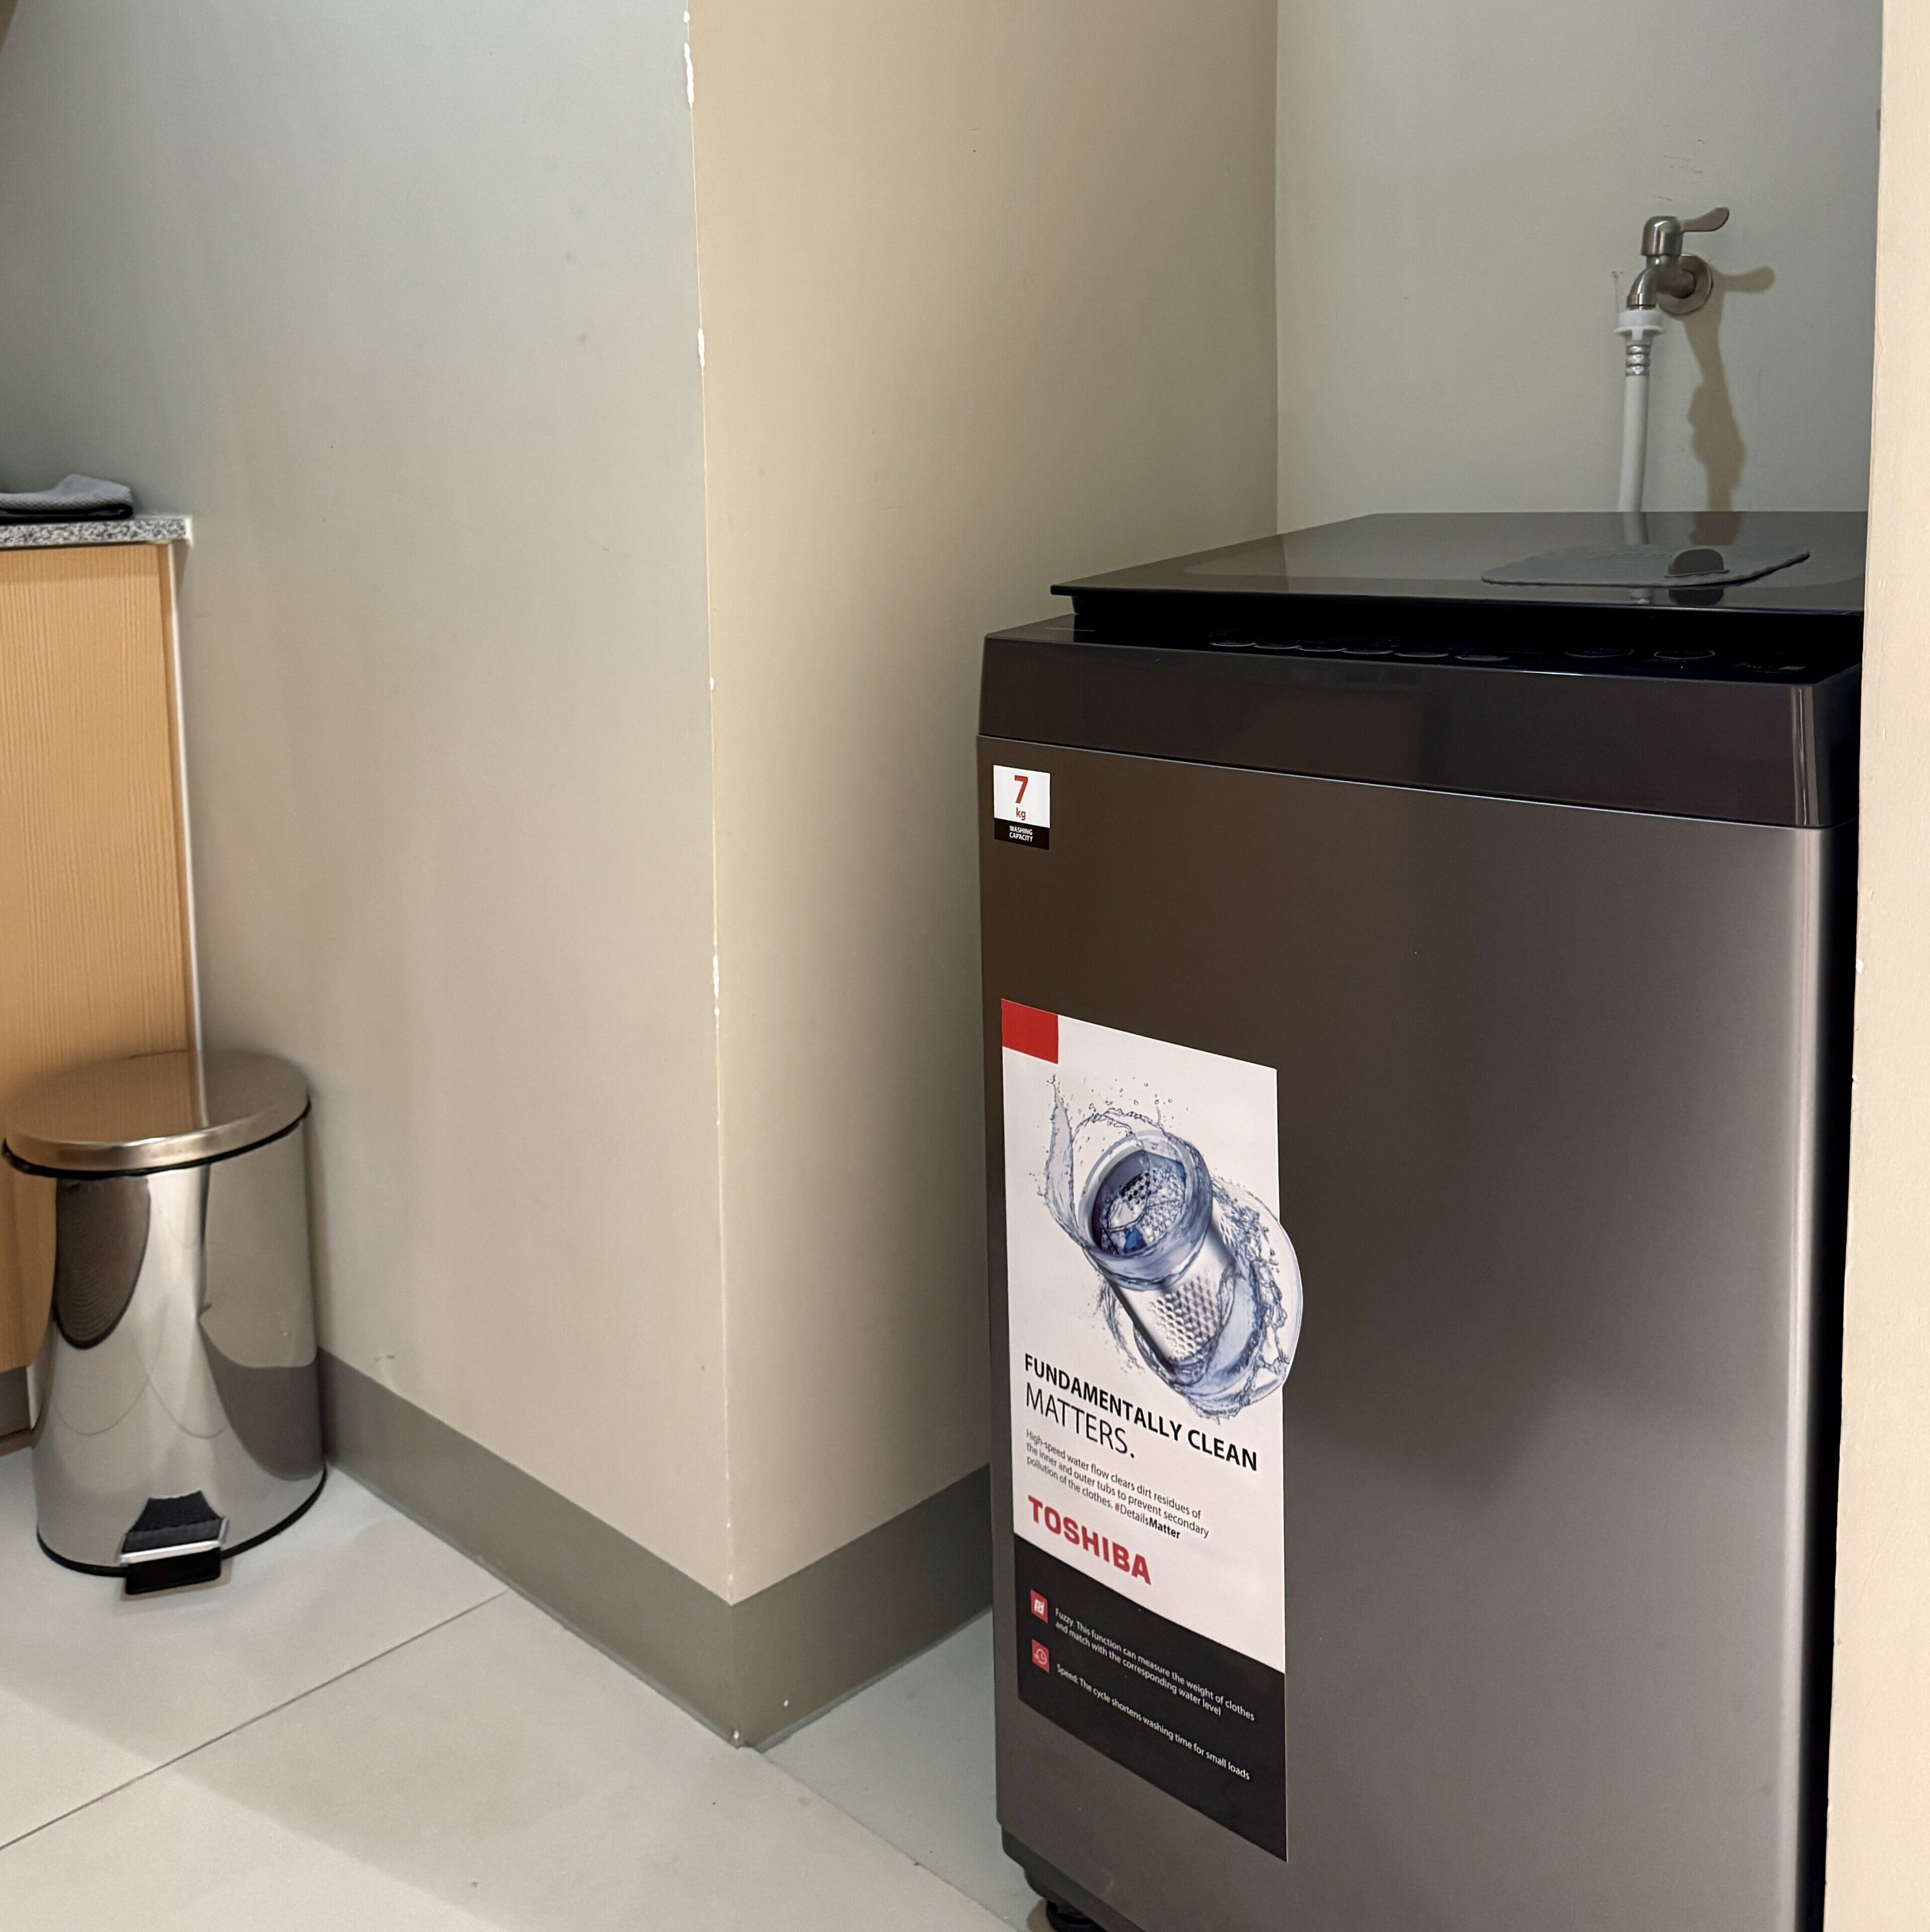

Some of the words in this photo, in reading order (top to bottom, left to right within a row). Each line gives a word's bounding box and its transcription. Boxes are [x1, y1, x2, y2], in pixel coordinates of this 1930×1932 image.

[1010, 826, 1033, 835] WASHING
[1015, 775, 1028, 804] 7
[1016, 807, 1026, 821] kg
[1009, 832, 1033, 842] CAPACITY
[1025, 1353, 1182, 1441] FUNDAMENTALLY
[1188, 1429, 1257, 1471] CLEAN
[1026, 1382, 1134, 1459] MATTERS.
[1027, 1429, 1065, 1459] High-speed
[1067, 1454, 1089, 1470] water
[1091, 1464, 1109, 1479] flow
[1111, 1474, 1135, 1490] clears
[1137, 1485, 1152, 1498] dirt
[1154, 1493, 1190, 1515] residues
[1192, 1510, 1201, 1519] of
[1027, 1442, 1038, 1456] the
[1039, 1449, 1057, 1467] inner
[1059, 1463, 1072, 1475] and
[1074, 1471, 1095, 1487] outer
[1098, 1481, 1115, 1495] tubs
[1118, 1490, 1126, 1500] to
[1128, 1496, 1161, 1516] prevent
[1164, 1511, 1209, 1539] secondary
[1027, 1457, 1058, 1480] pollution
[1060, 1476, 1067, 1485] of
[1068, 1479, 1080, 1492] the
[1082, 1487, 1113, 1509] clothes.
[1115, 1503, 1180, 1539] #DetailsMatter
[1028, 1495, 1151, 1585] TOSHIBA
[1056, 1621, 1068, 1634] and
[1069, 1630, 1090, 1647] match
[1092, 1642, 1108, 1656] with
[1109, 1651, 1122, 1663] the
[1123, 1659, 1177, 1695] corresponding
[1179, 1688, 1201, 1705] water
[1202, 1700, 1221, 1716] level
[1076, 1621, 1090, 1636] This
[1092, 1630, 1122, 1653] function
[1123, 1648, 1136, 1660] can
[1138, 1655, 1170, 1677] measure
[1171, 1672, 1185, 1684] the
[1186, 1680, 1213, 1700] weight
[1215, 1696, 1224, 1705] of
[1225, 1700, 1254, 1721] clothes
[1079, 1677, 1093, 1693] The
[1093, 1688, 1111, 1703] cycle
[1112, 1698, 1142, 1721] shortens
[1143, 1716, 1173, 1740] washing
[1175, 1733, 1192, 1750] time
[1194, 1742, 1204, 1756] for
[1206, 1752, 1226, 1768] small
[1228, 1761, 1250, 1781] loads
